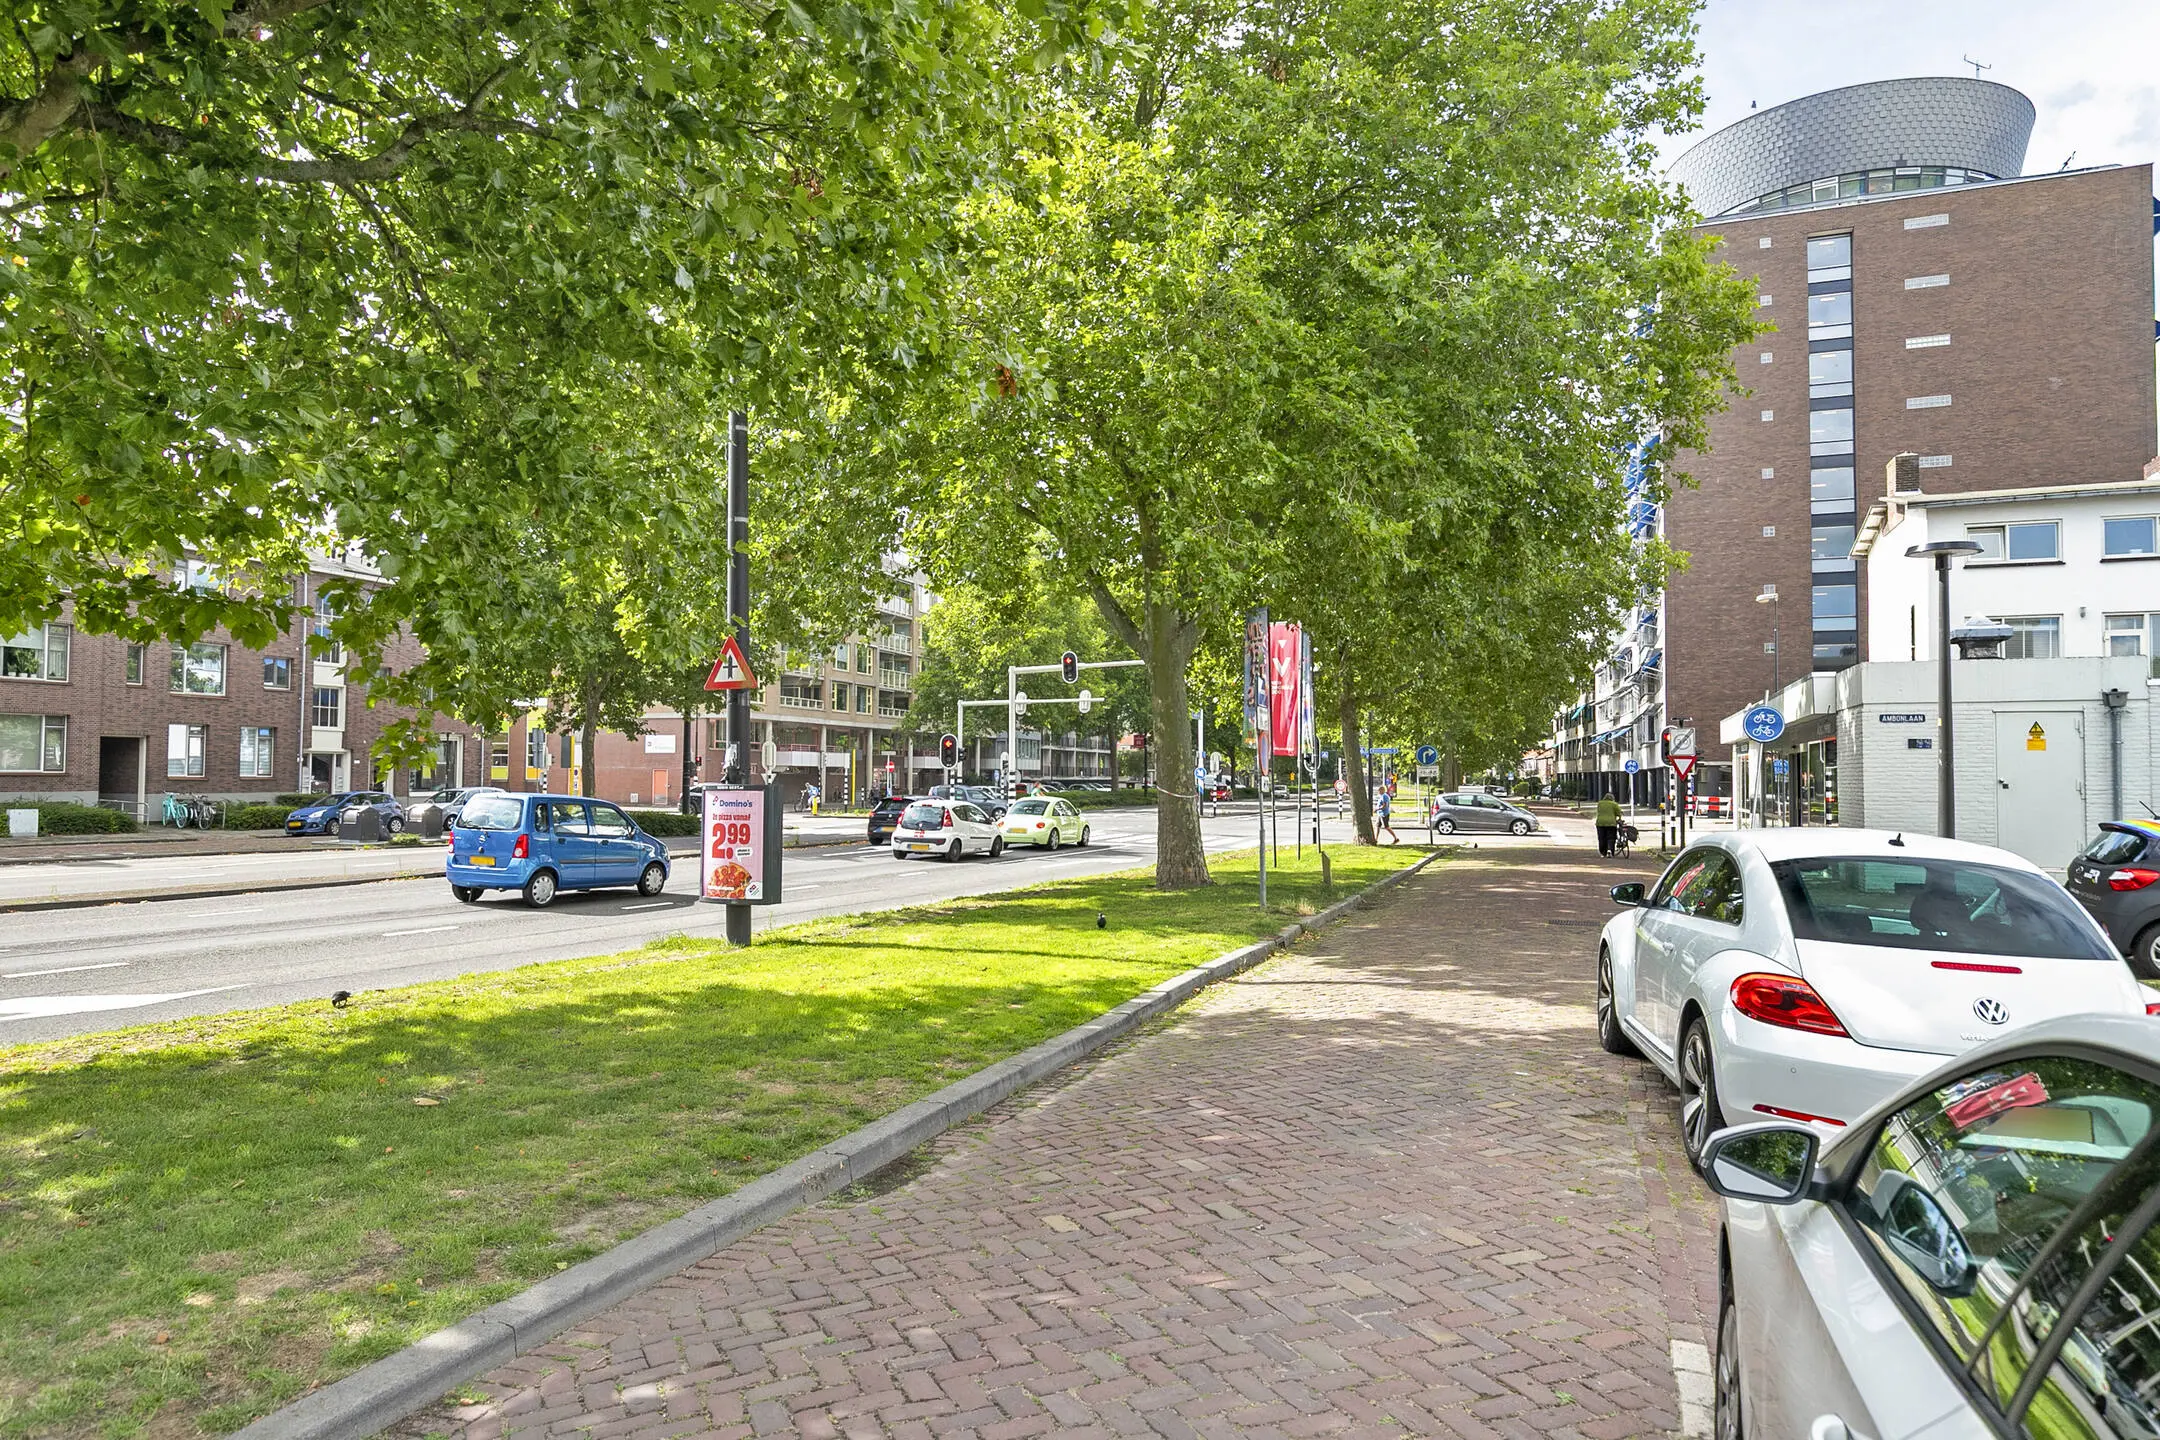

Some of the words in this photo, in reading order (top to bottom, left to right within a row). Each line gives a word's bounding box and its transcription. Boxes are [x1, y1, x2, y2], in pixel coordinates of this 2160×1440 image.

[719, 799, 753, 808] Domino's
[719, 812, 732, 821] pizza
[733, 813, 751, 821] vanaf
